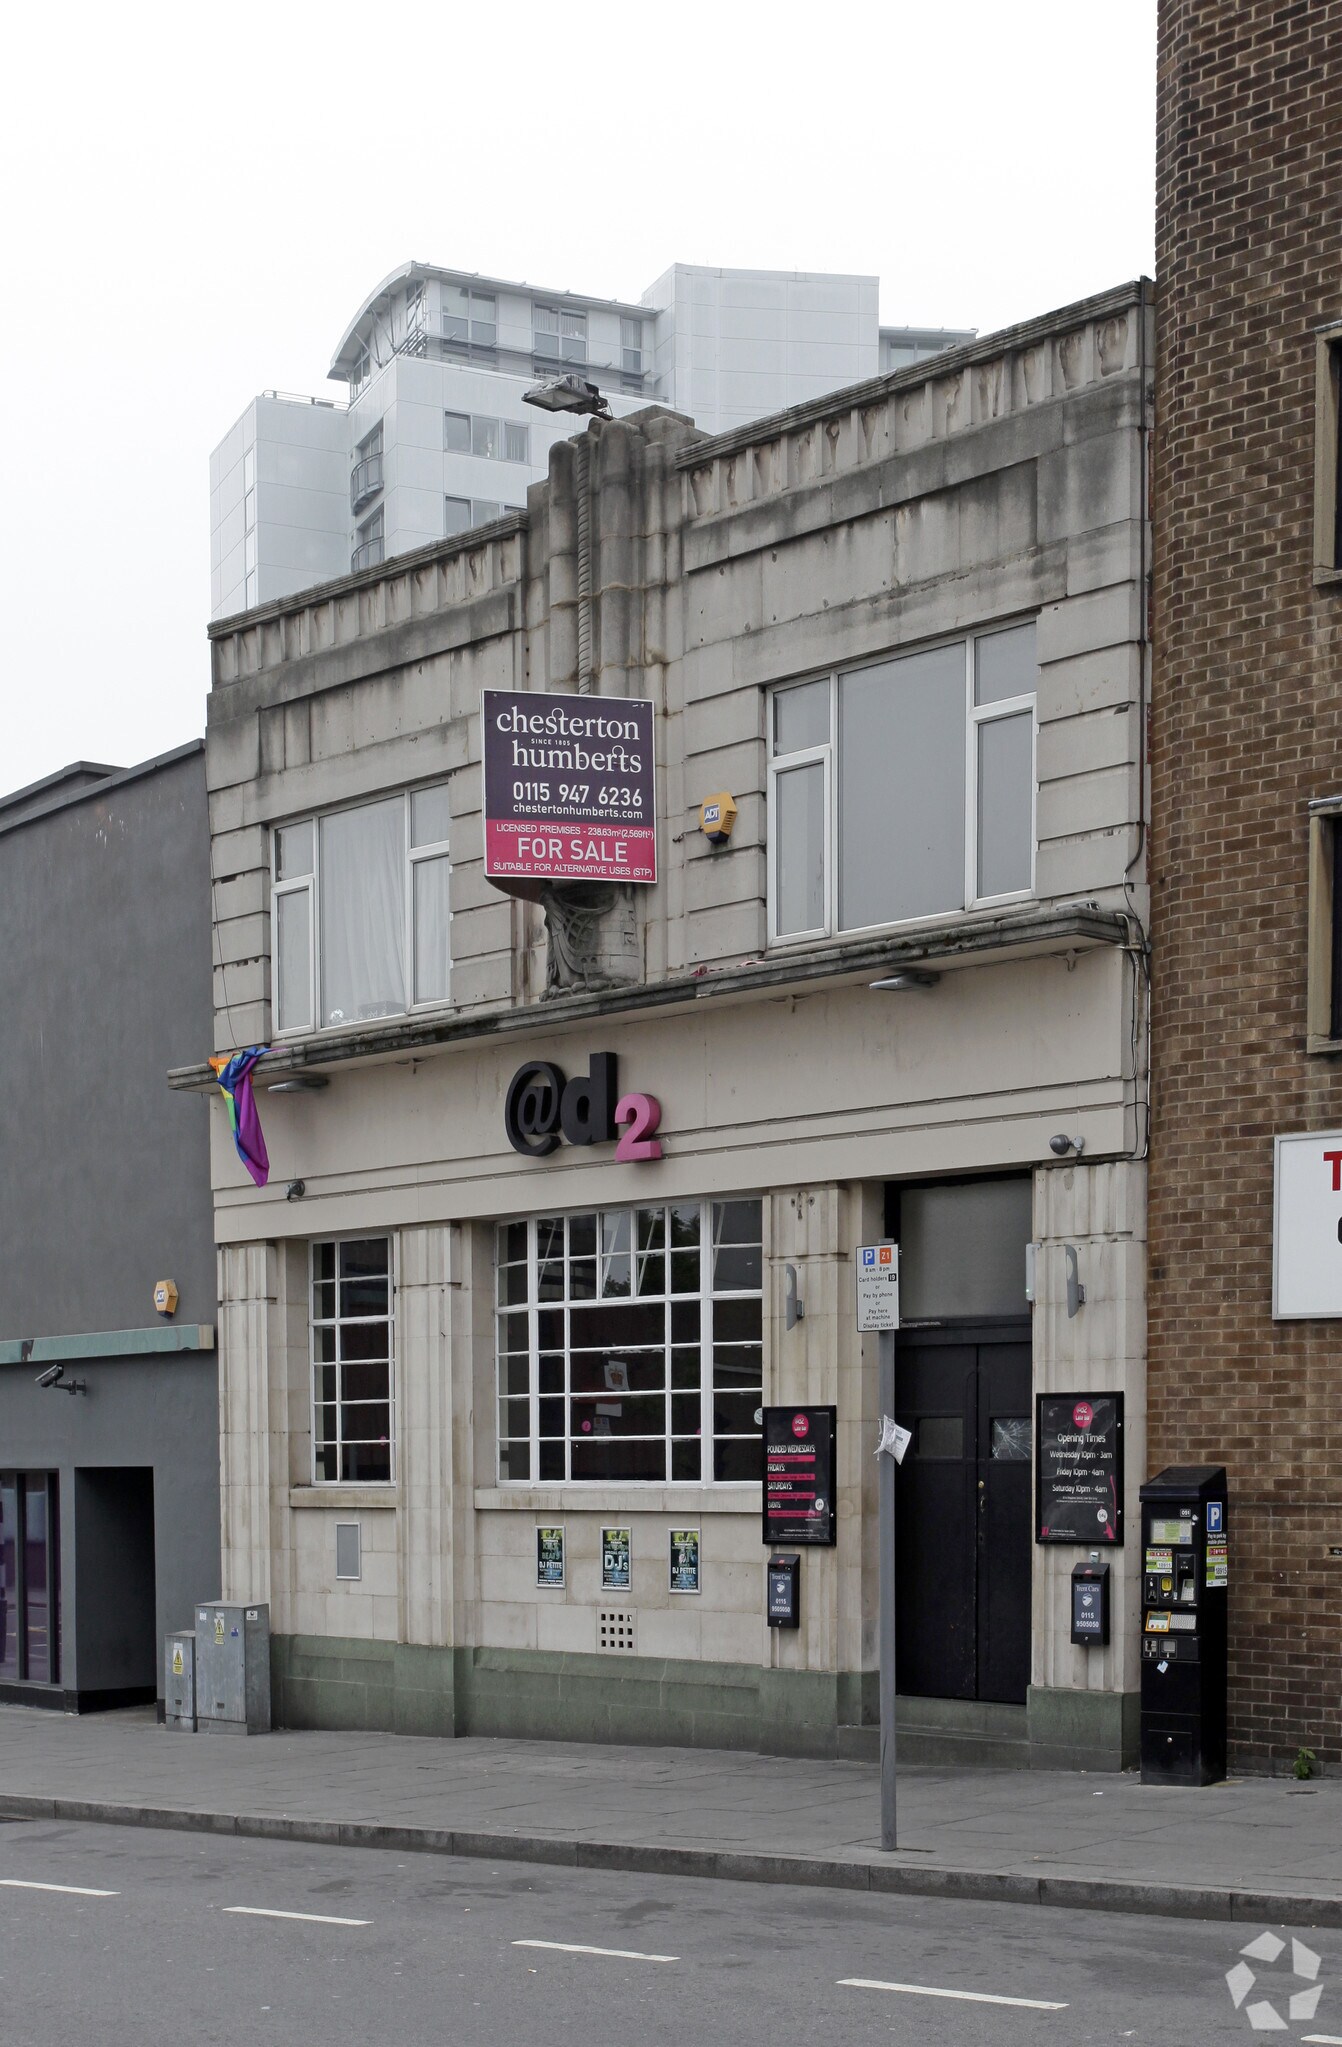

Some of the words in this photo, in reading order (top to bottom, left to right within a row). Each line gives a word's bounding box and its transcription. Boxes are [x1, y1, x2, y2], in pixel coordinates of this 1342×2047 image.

[496, 706, 640, 740] chesterton
[512, 739, 642, 774] humberts
[513, 781, 550, 802] 0115
[559, 783, 590, 804] 947
[598, 786, 643, 807] 6236
[513, 803, 643, 819] chestertonhumberts.com
[705, 807, 719, 820] ADT
[496, 823, 537, 833] LICENSED
[539, 825, 581, 835] PREMISES
[517, 837, 563, 859] FOR
[570, 839, 628, 863] SALE
[493, 862, 532, 871] SUITABLE
[534, 863, 552, 872] FOR
[554, 864, 607, 874] ALTERNATIVE
[609, 866, 631, 875] USES
[633, 867, 653, 877] (STP)
[881, 1252, 890, 1260] Z1
[1057, 1433, 1084, 1445] Opening
[1086, 1433, 1106, 1443] Times
[767, 1445, 787, 1454] POUNDED
[1050, 1450, 1081, 1461] Wednesday
[1081, 1451, 1096, 1460] 10pm
[1100, 1450, 1113, 1459] 3am
[1056, 1468, 1072, 1478] Friday
[1073, 1468, 1088, 1478] 10pm
[1091, 1468, 1105, 1476] 4am
[1052, 1485, 1075, 1495] Saturday
[1075, 1485, 1091, 1495] 10pm
[1094, 1485, 1108, 1493] 4am
[539, 1561, 546, 1570] DJ
[546, 1561, 562, 1569] PETITE
[672, 1566, 679, 1574] DJ
[679, 1567, 696, 1575] PETITE
[1076, 1620, 1099, 1628] 9505050
